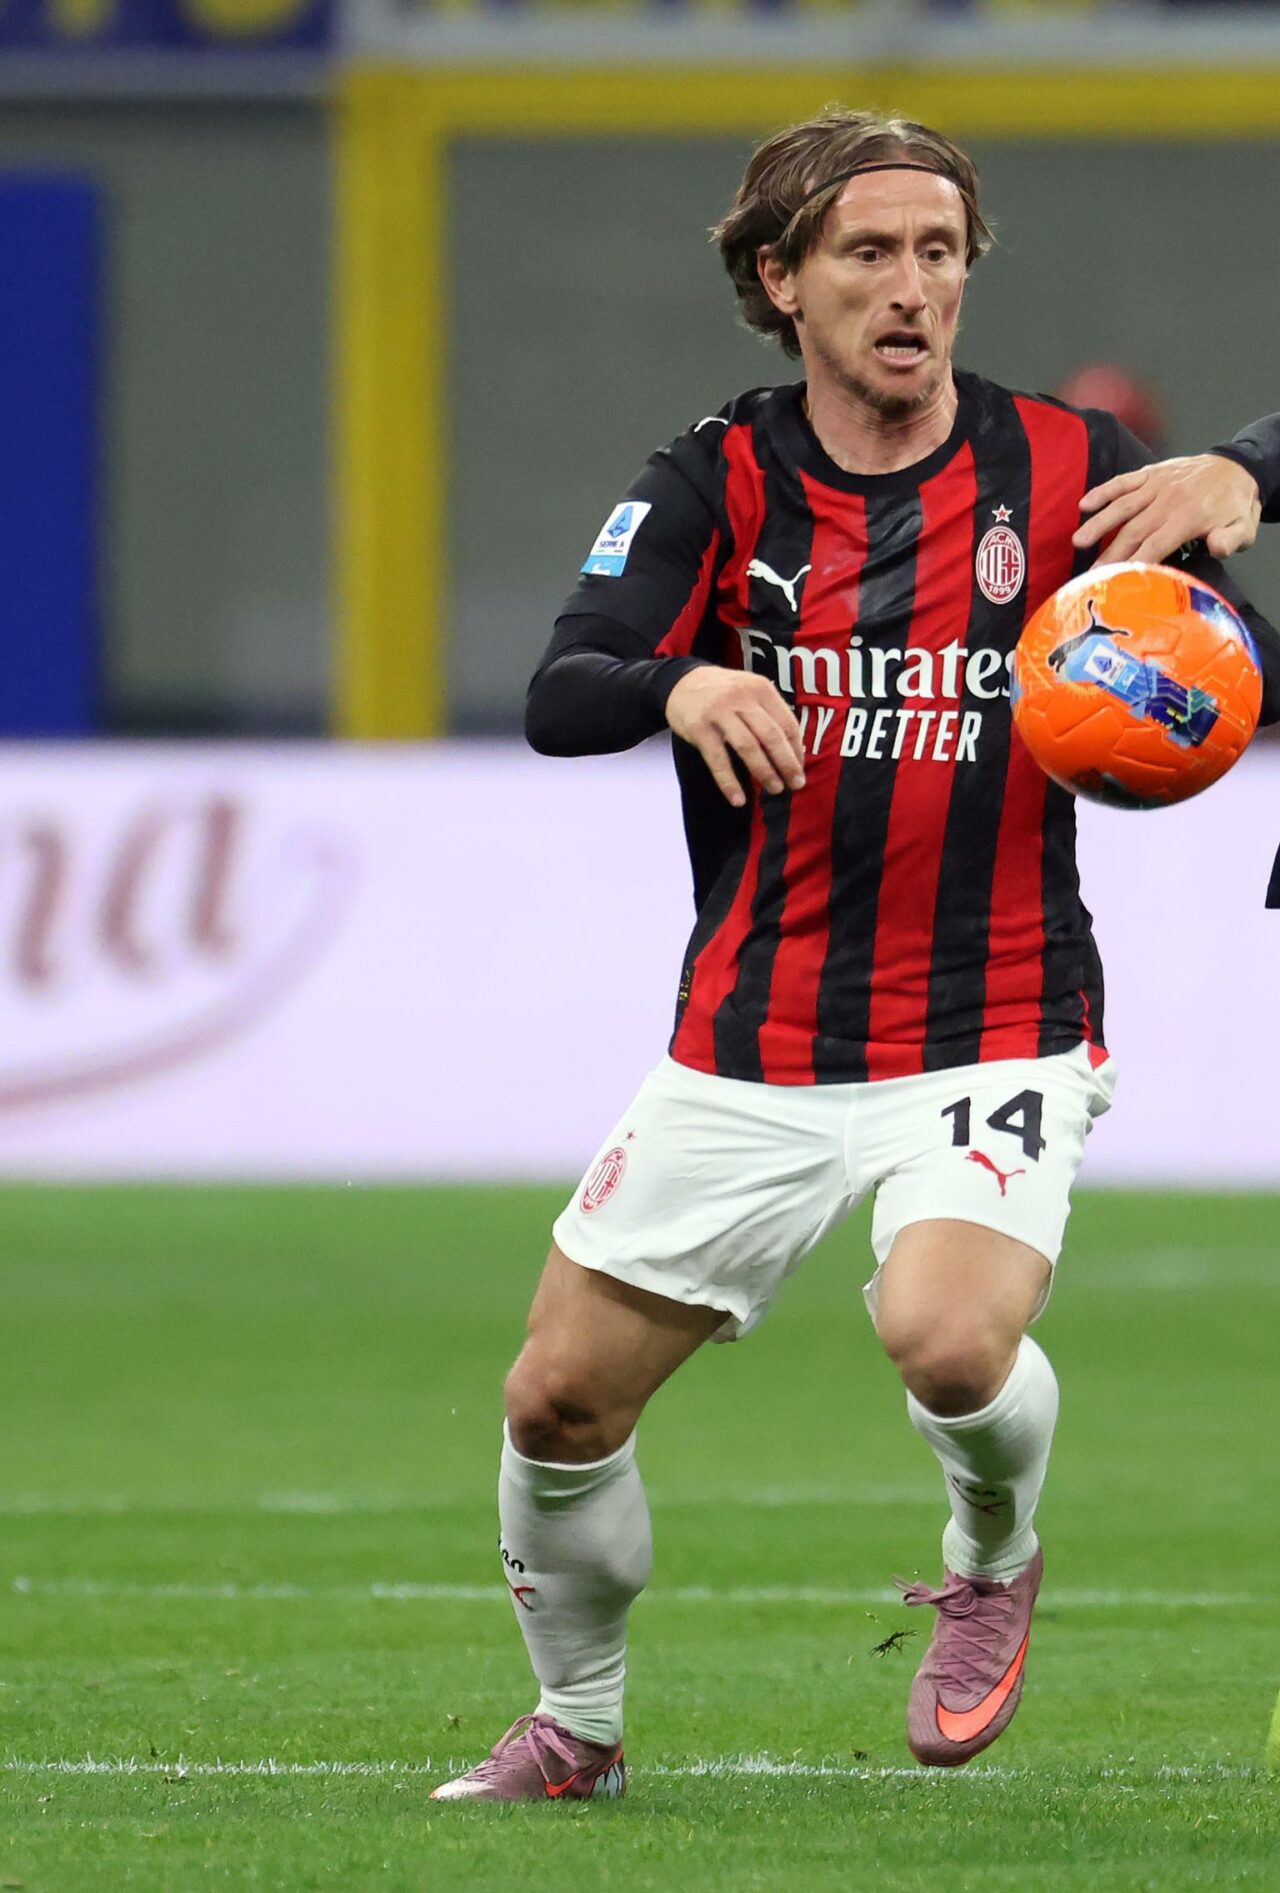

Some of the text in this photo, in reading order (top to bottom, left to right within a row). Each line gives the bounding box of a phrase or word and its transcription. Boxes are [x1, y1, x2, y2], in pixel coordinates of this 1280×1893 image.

[988, 532, 1015, 548] ACM
[987, 584, 1012, 595] 1899
[839, 706, 983, 763] BETTER
[940, 1088, 1047, 1163] 14
